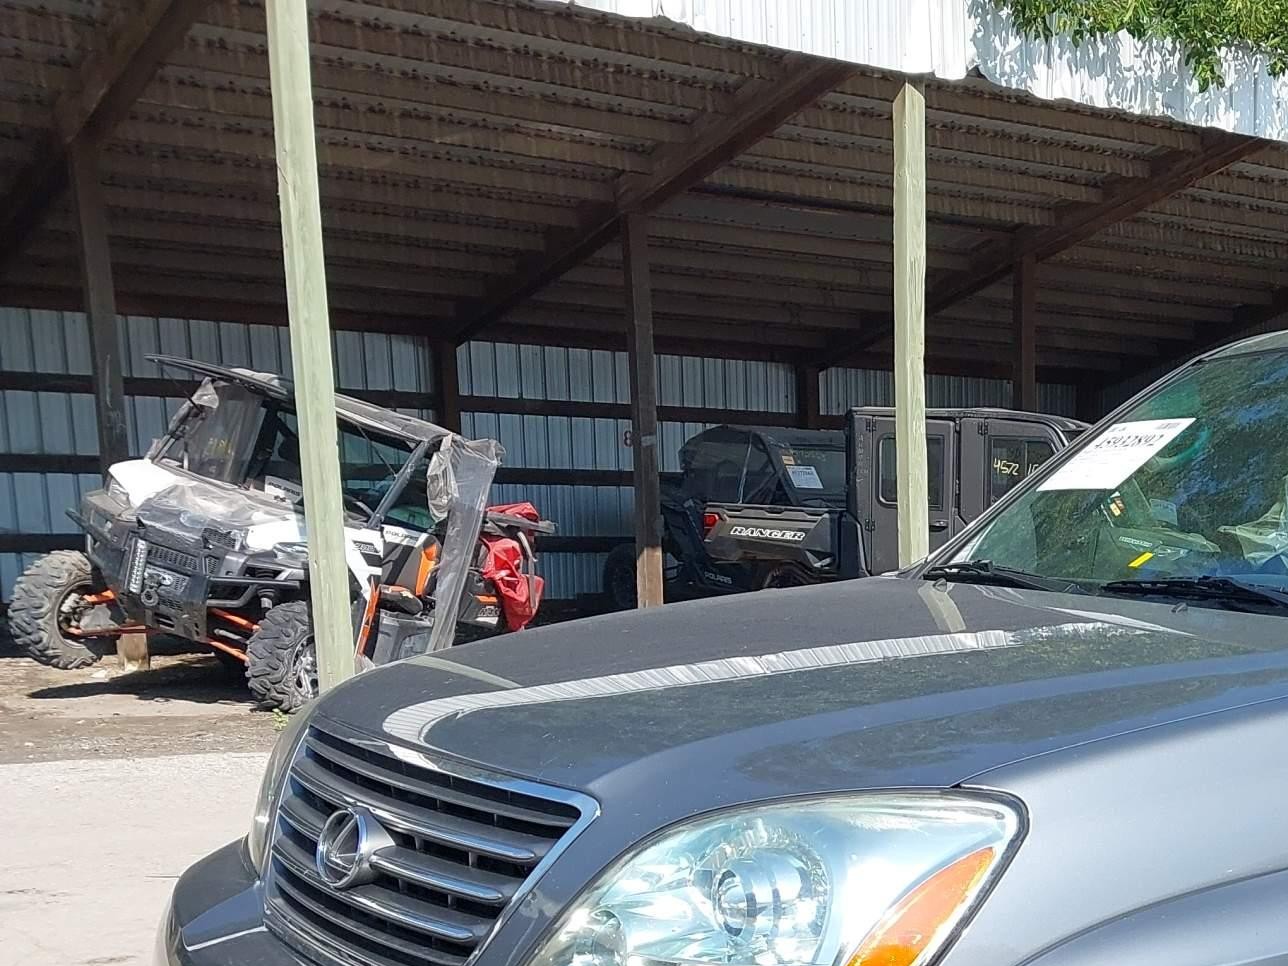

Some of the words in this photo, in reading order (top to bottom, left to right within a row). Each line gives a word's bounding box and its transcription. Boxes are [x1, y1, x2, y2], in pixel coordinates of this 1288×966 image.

[993, 457, 1020, 476] 4572
[730, 526, 806, 541] RANGER
[703, 570, 733, 585] POLARIS
